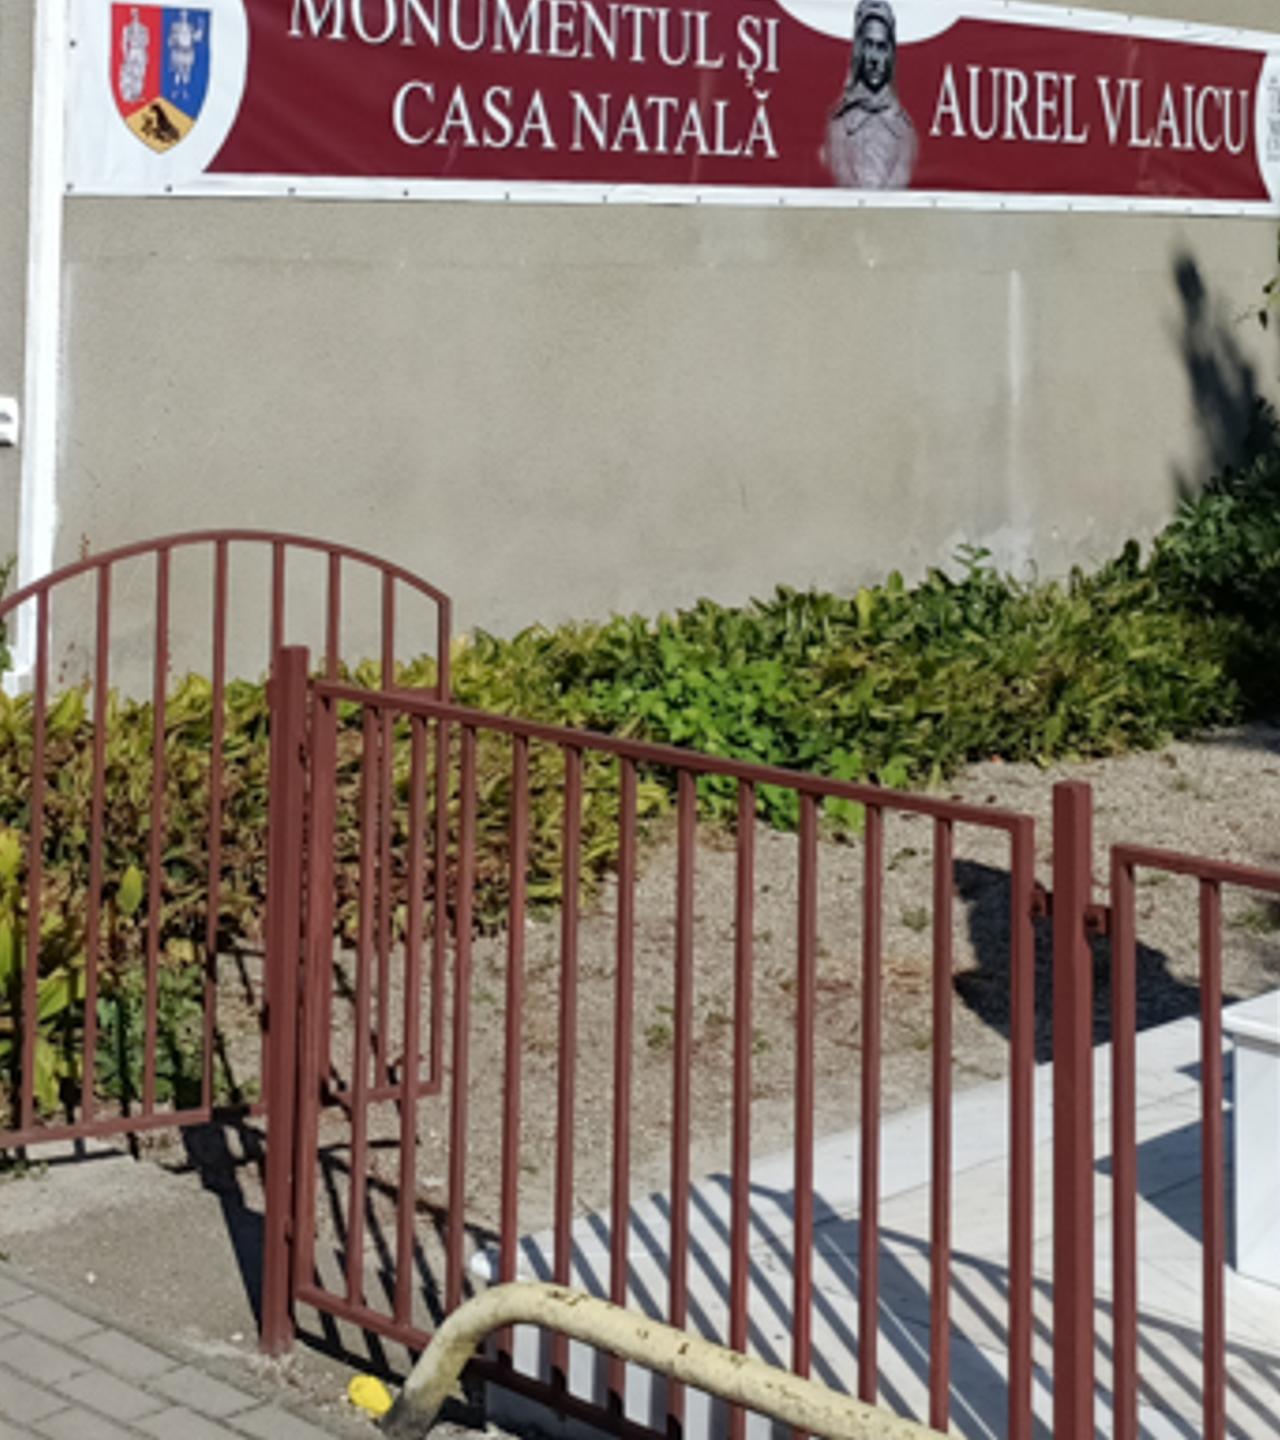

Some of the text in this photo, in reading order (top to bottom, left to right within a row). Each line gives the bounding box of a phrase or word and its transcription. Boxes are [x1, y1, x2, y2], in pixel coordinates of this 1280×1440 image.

[392, 80, 779, 160] CASA NATALĂ
[929, 64, 1088, 144] AUREL
[1096, 77, 1249, 154] VLAICU
